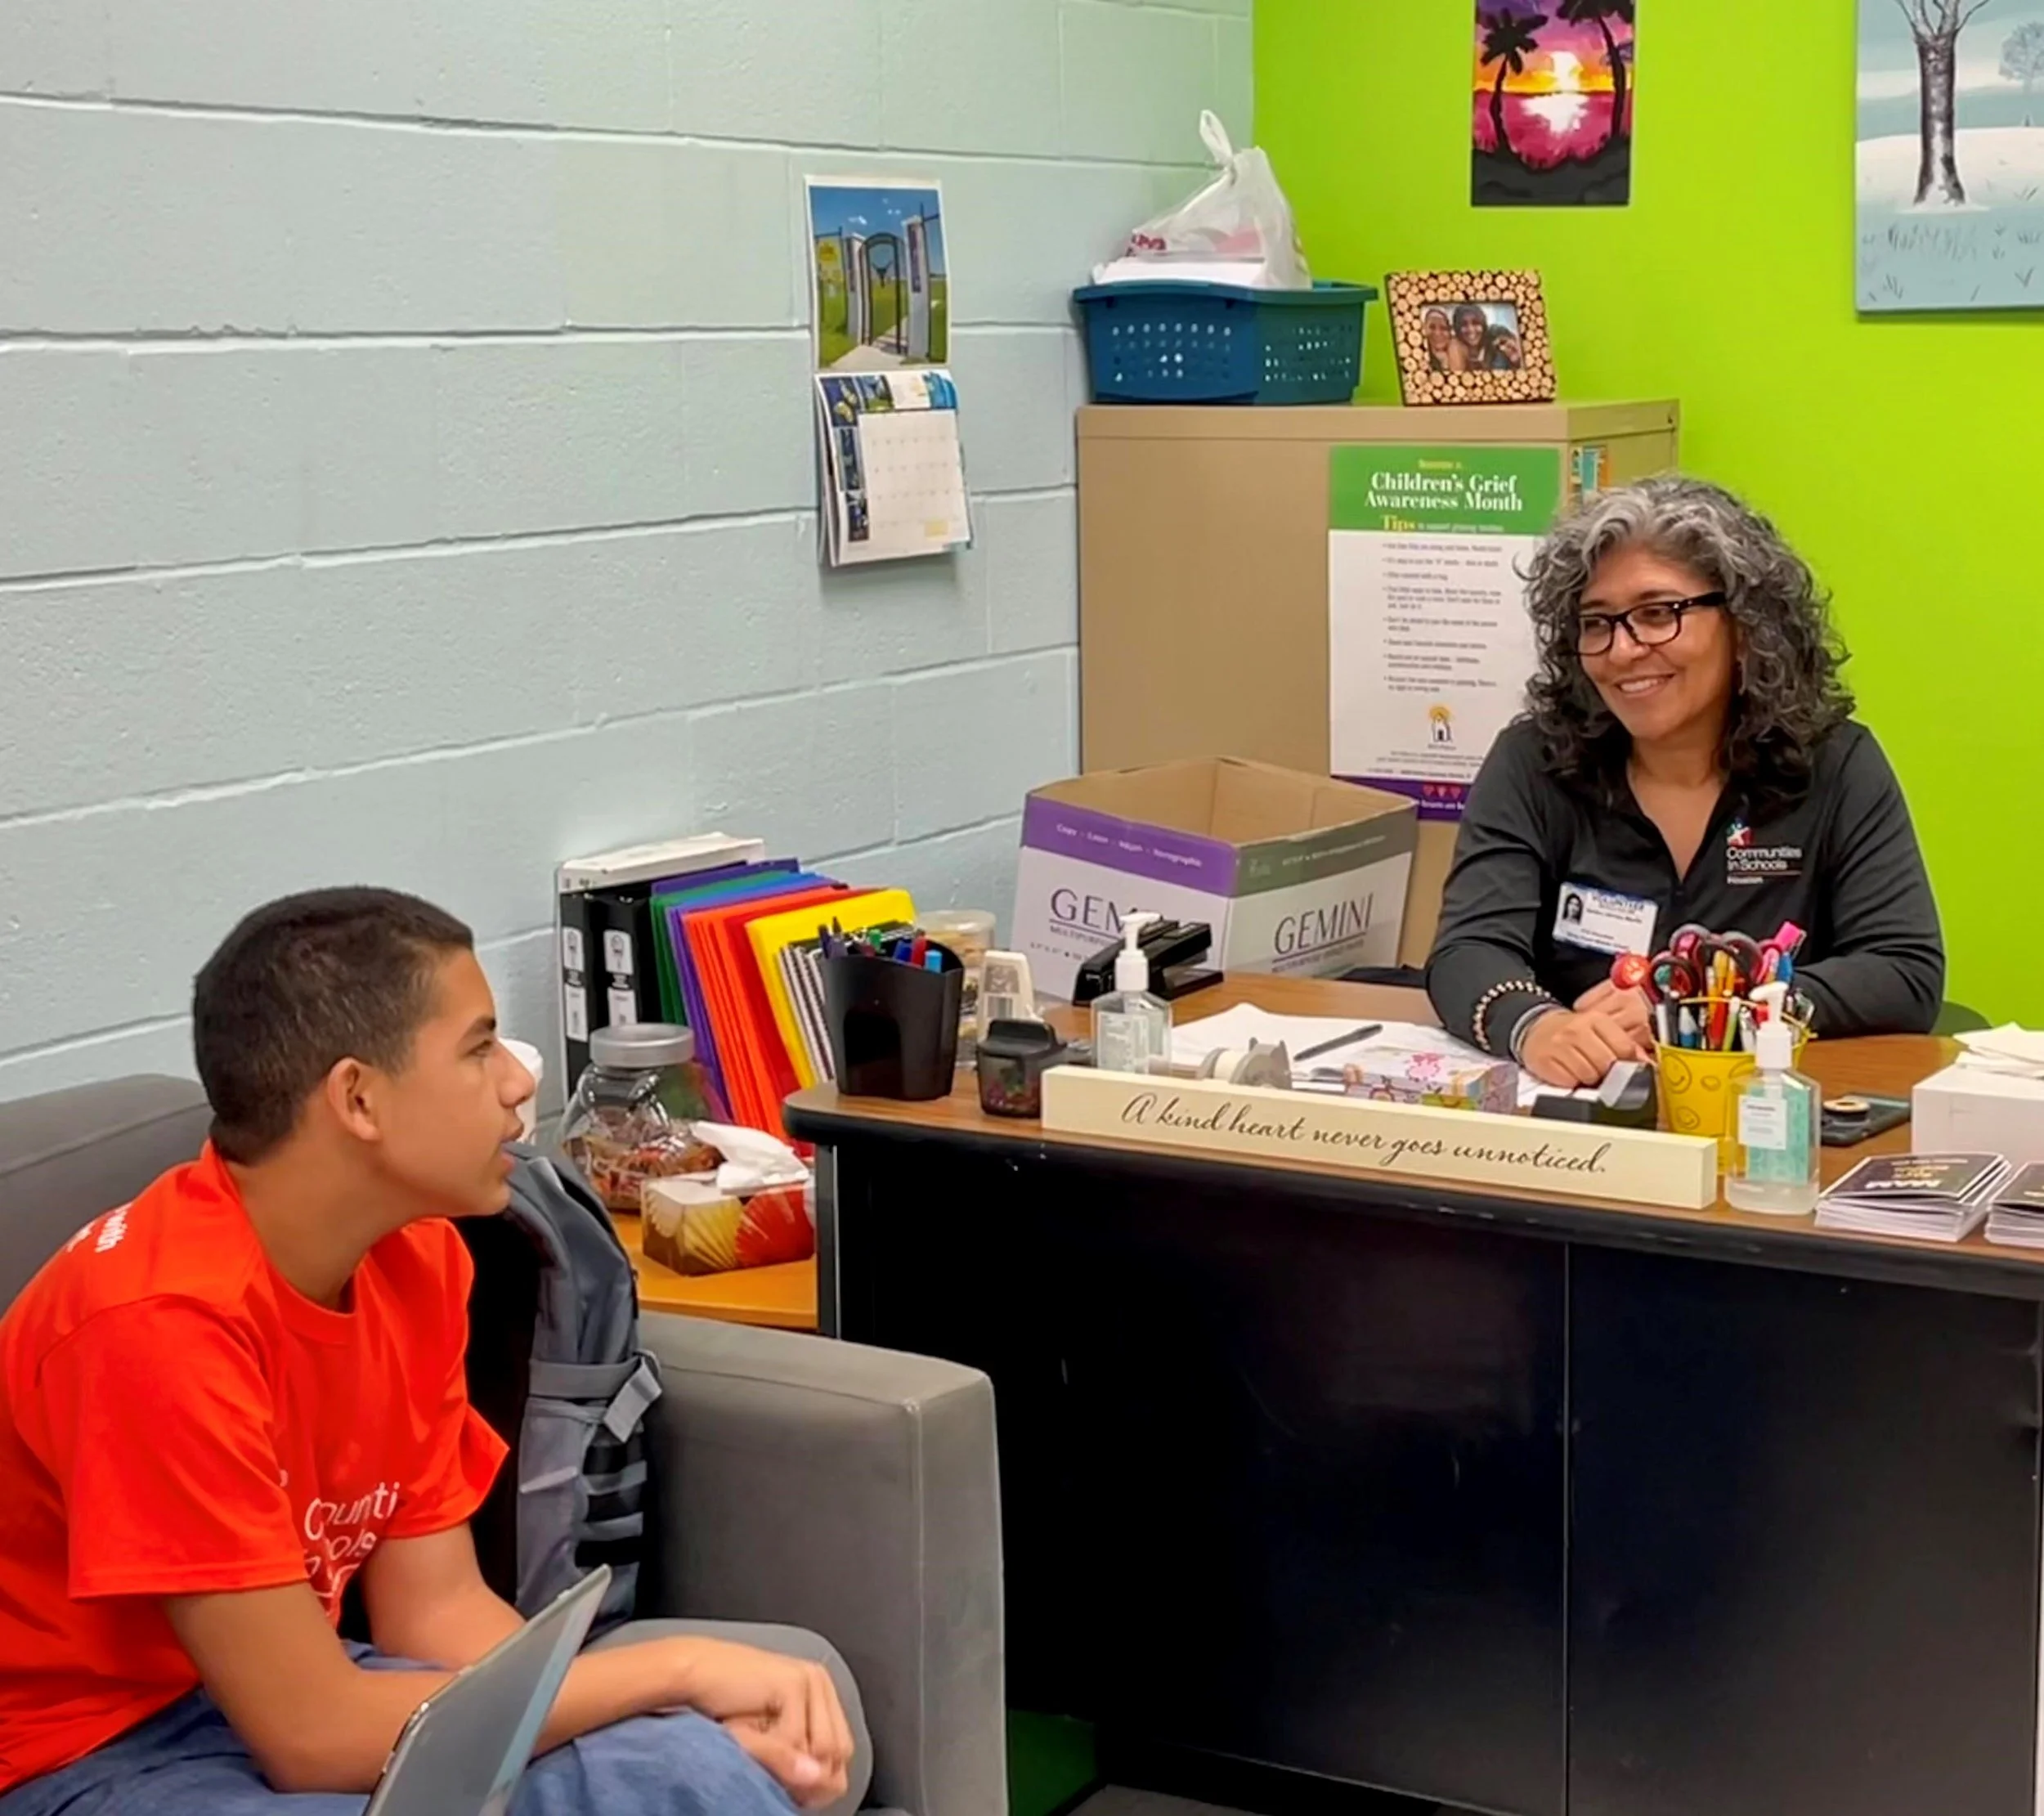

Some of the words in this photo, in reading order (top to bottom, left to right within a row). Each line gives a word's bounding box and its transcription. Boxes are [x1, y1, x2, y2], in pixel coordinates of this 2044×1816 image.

[1371, 470, 1464, 491] Children's
[1469, 473, 1518, 492] Grief
[1365, 491, 1459, 509] Awareness
[1464, 491, 1523, 511] Month
[1381, 514, 1417, 532] Tips
[1727, 846, 1802, 859] Communities
[1740, 859, 1788, 872] Schools
[1051, 889, 1138, 934] GEM
[1274, 892, 1374, 955] GEMINI
[1122, 1093, 1154, 1124] A
[1155, 1098, 1230, 1132] kind
[1229, 1105, 1306, 1141] heart
[1312, 1128, 1386, 1151] never
[1384, 1137, 1445, 1167] goes
[1454, 1141, 1608, 1174] unnoticed.
